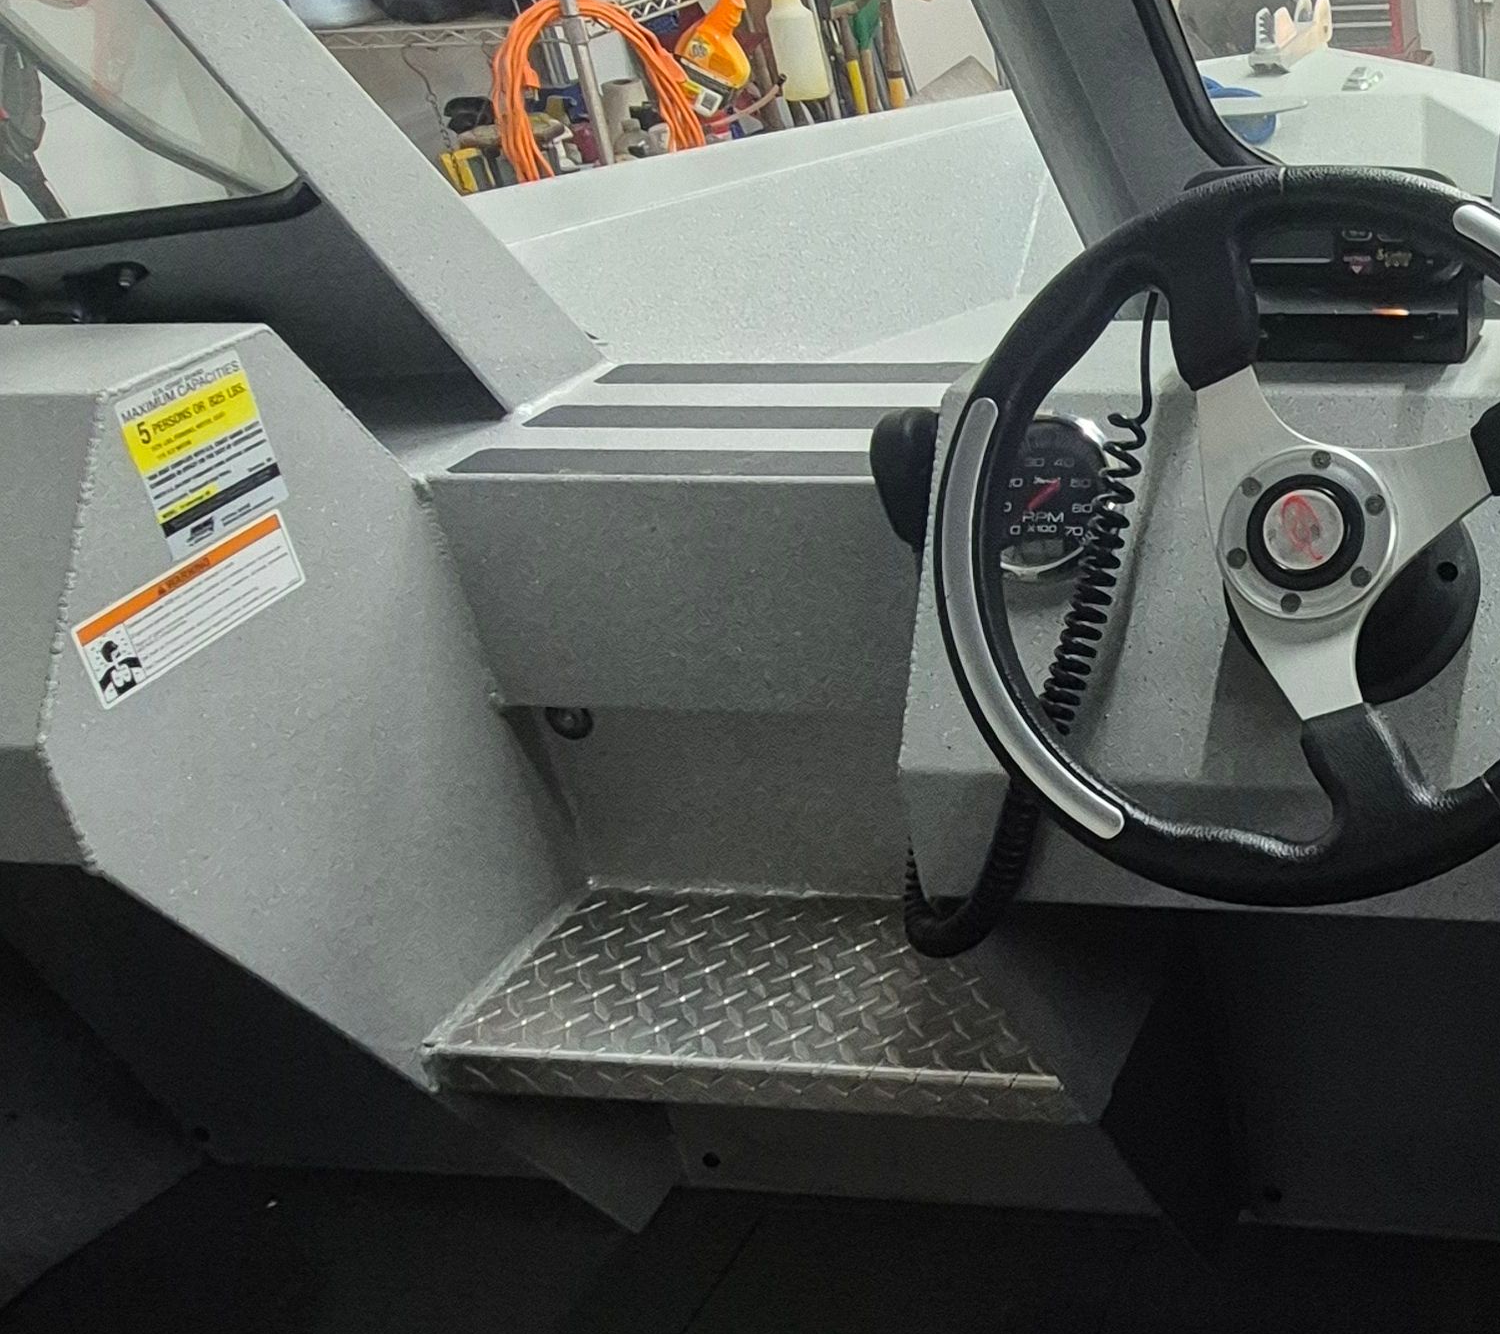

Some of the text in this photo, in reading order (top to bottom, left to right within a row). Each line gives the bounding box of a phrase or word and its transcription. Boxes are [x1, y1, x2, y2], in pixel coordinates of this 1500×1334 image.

[120, 358, 240, 424] MAXIMUM CAPACITIES
[134, 419, 152, 446] 5
[150, 405, 193, 435] PERSONS
[1022, 511, 1065, 523] RPM
[1065, 526, 1083, 536] 70
